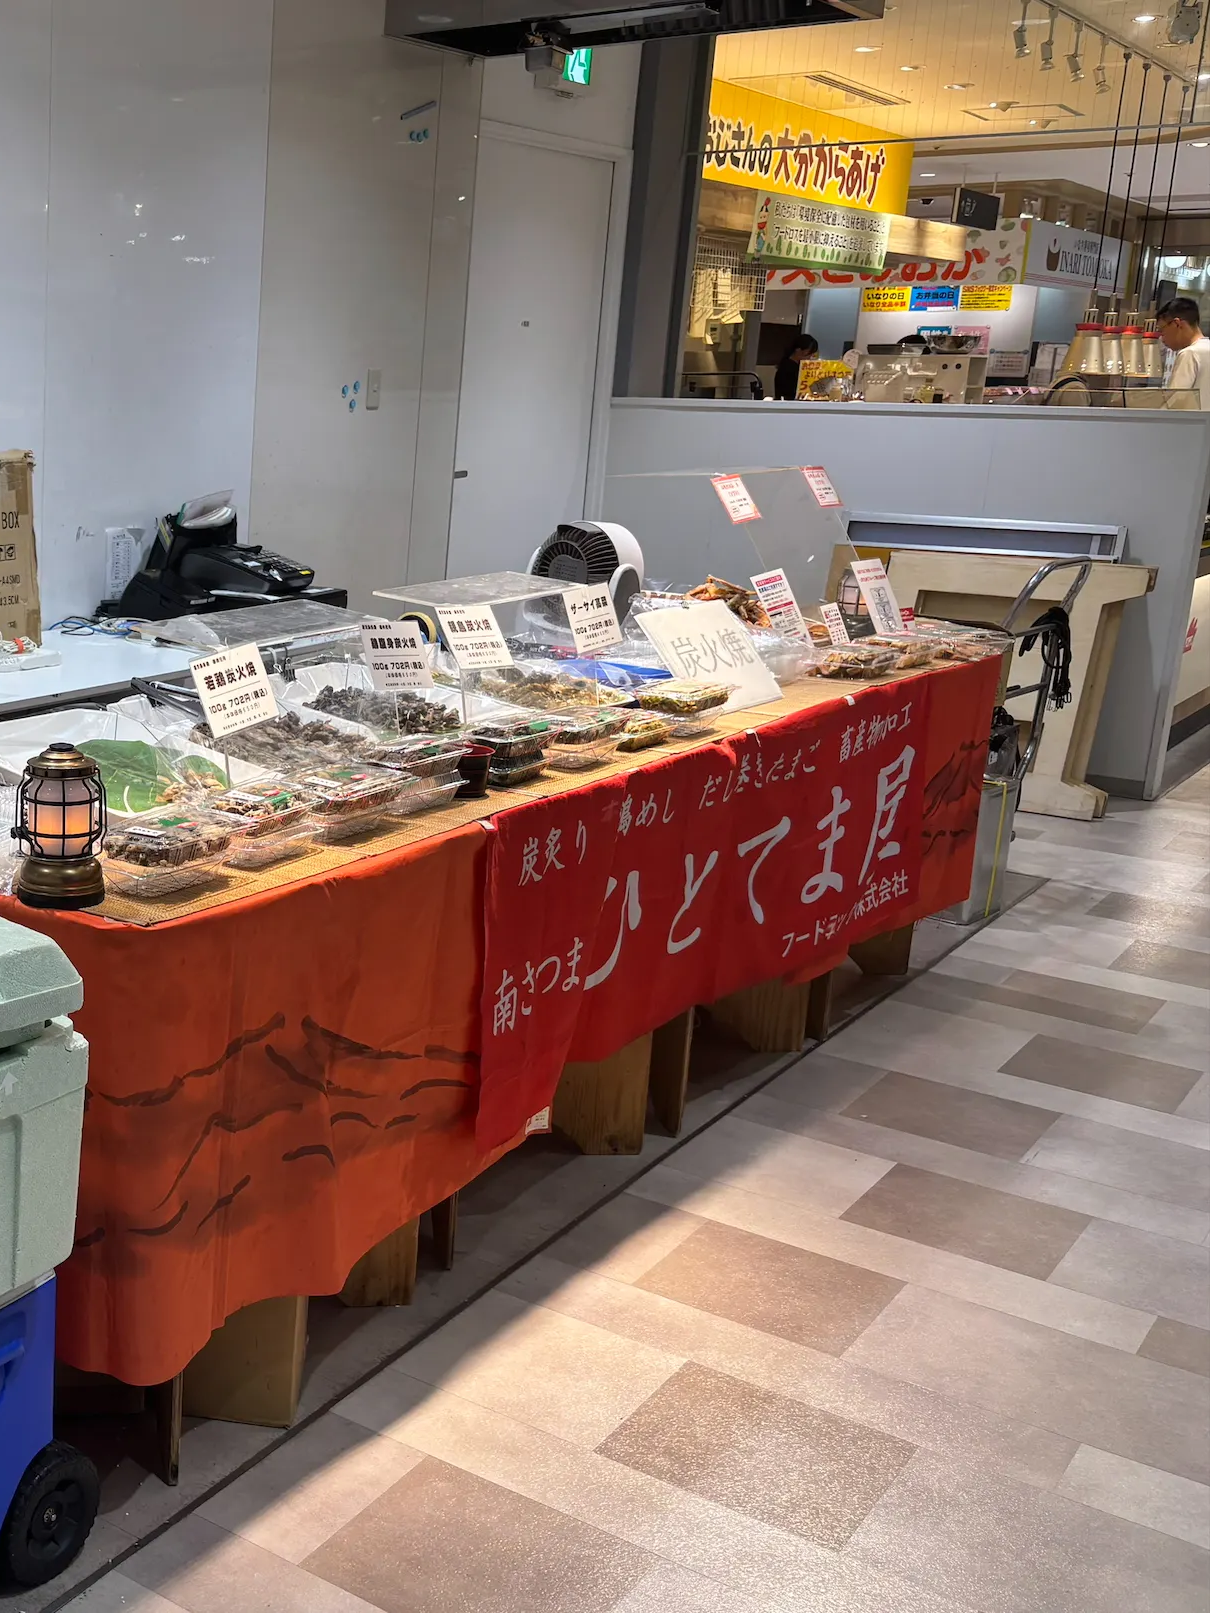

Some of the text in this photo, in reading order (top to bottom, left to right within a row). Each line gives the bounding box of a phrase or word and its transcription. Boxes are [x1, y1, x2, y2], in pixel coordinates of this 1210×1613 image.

[1081, 254, 1113, 281] TOMOKA
[866, 291, 905, 300] いなりの日
[915, 291, 955, 300] お弁当の日
[1, 511, 20, 530] BOX
[671, 627, 755, 679] 炭火焼
[208, 703, 227, 715] 100g
[839, 701, 913, 764] 畜産物加工
[583, 745, 917, 991] ひとてま屋
[492, 936, 584, 1037] 南さつま
